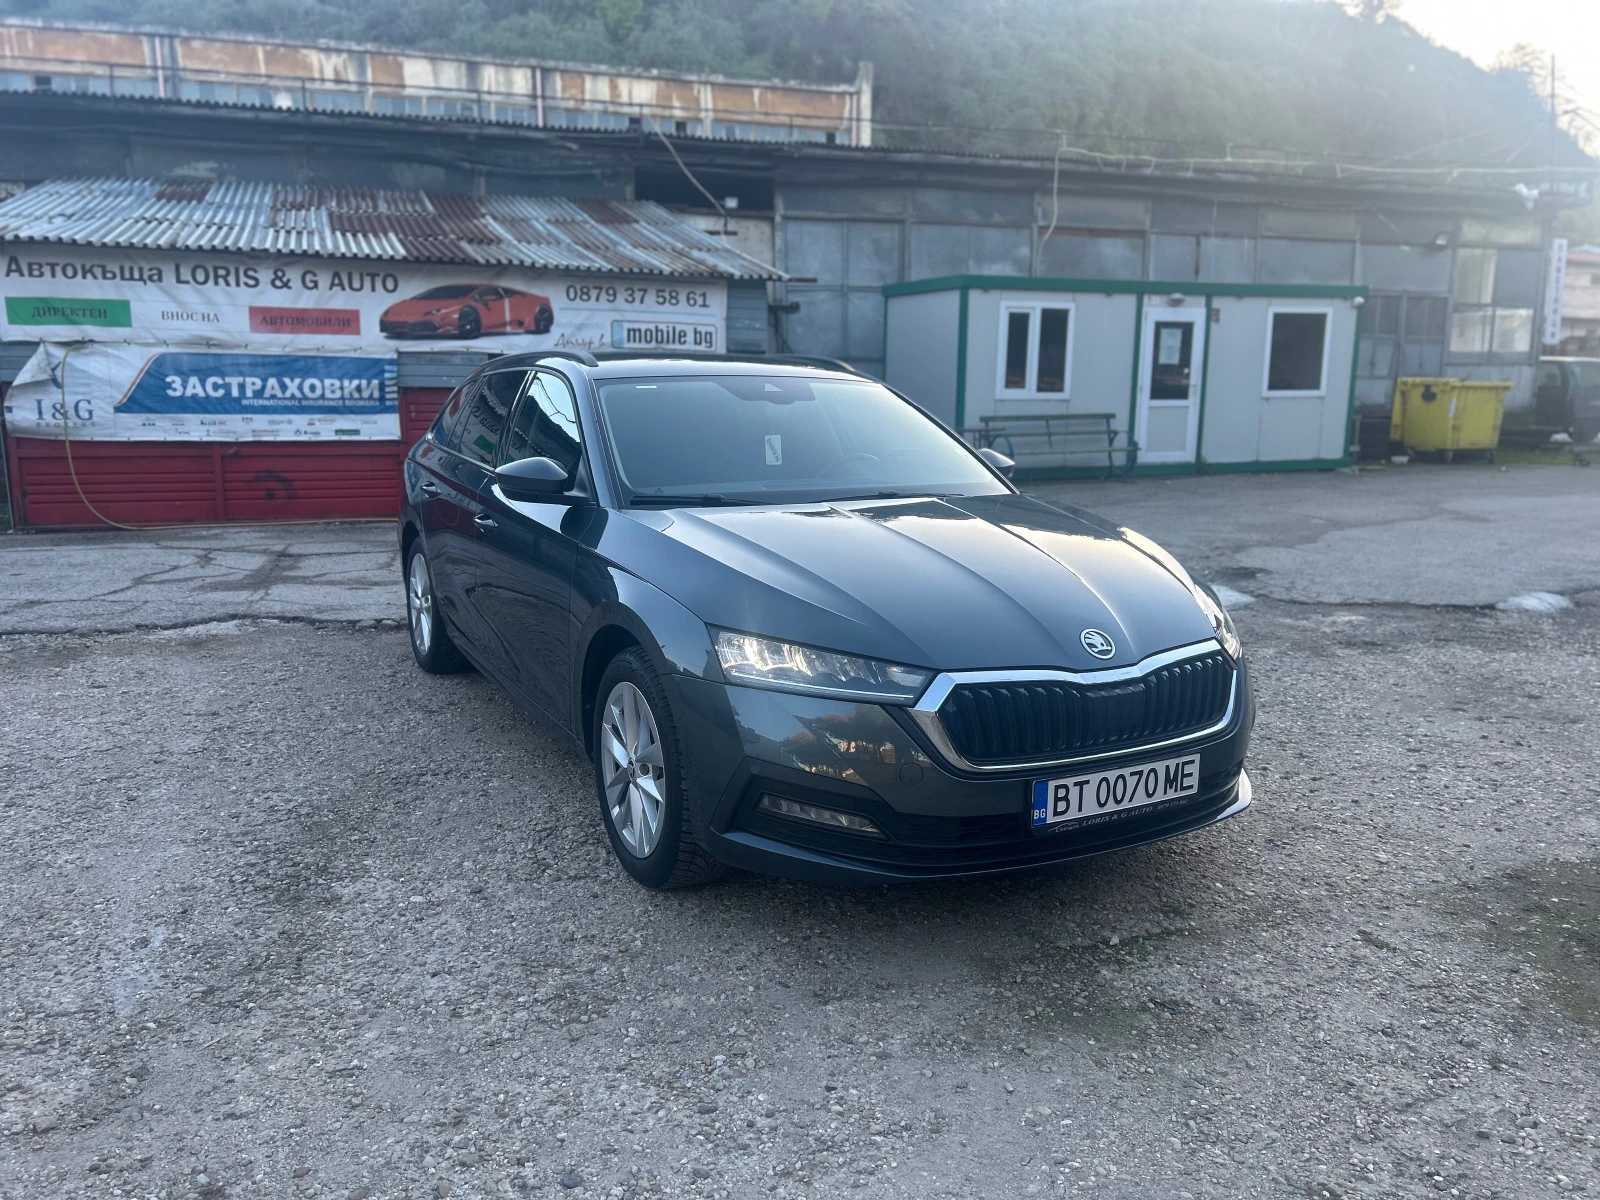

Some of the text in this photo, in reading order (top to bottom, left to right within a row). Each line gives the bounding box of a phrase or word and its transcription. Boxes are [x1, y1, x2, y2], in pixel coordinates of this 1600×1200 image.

[5, 255, 399, 294] Автокъща LORIS & G AUTO
[565, 285, 711, 308] 0879 37 58 61
[31, 306, 352, 328] ДИРЕКТЕН ВНОС НА АВТОМОБИЛИ
[165, 375, 381, 399] ЗАСТРАХОВКИ
[35, 398, 96, 421] I & G
[301, 399, 344, 407] INSURANCE
[1052, 759, 1196, 818] BT 0070 ME
[1033, 808, 1046, 820] BG
[1082, 815, 1110, 827] LORIS
[1121, 811, 1129, 819] G
[1128, 806, 1154, 817] AUTO
